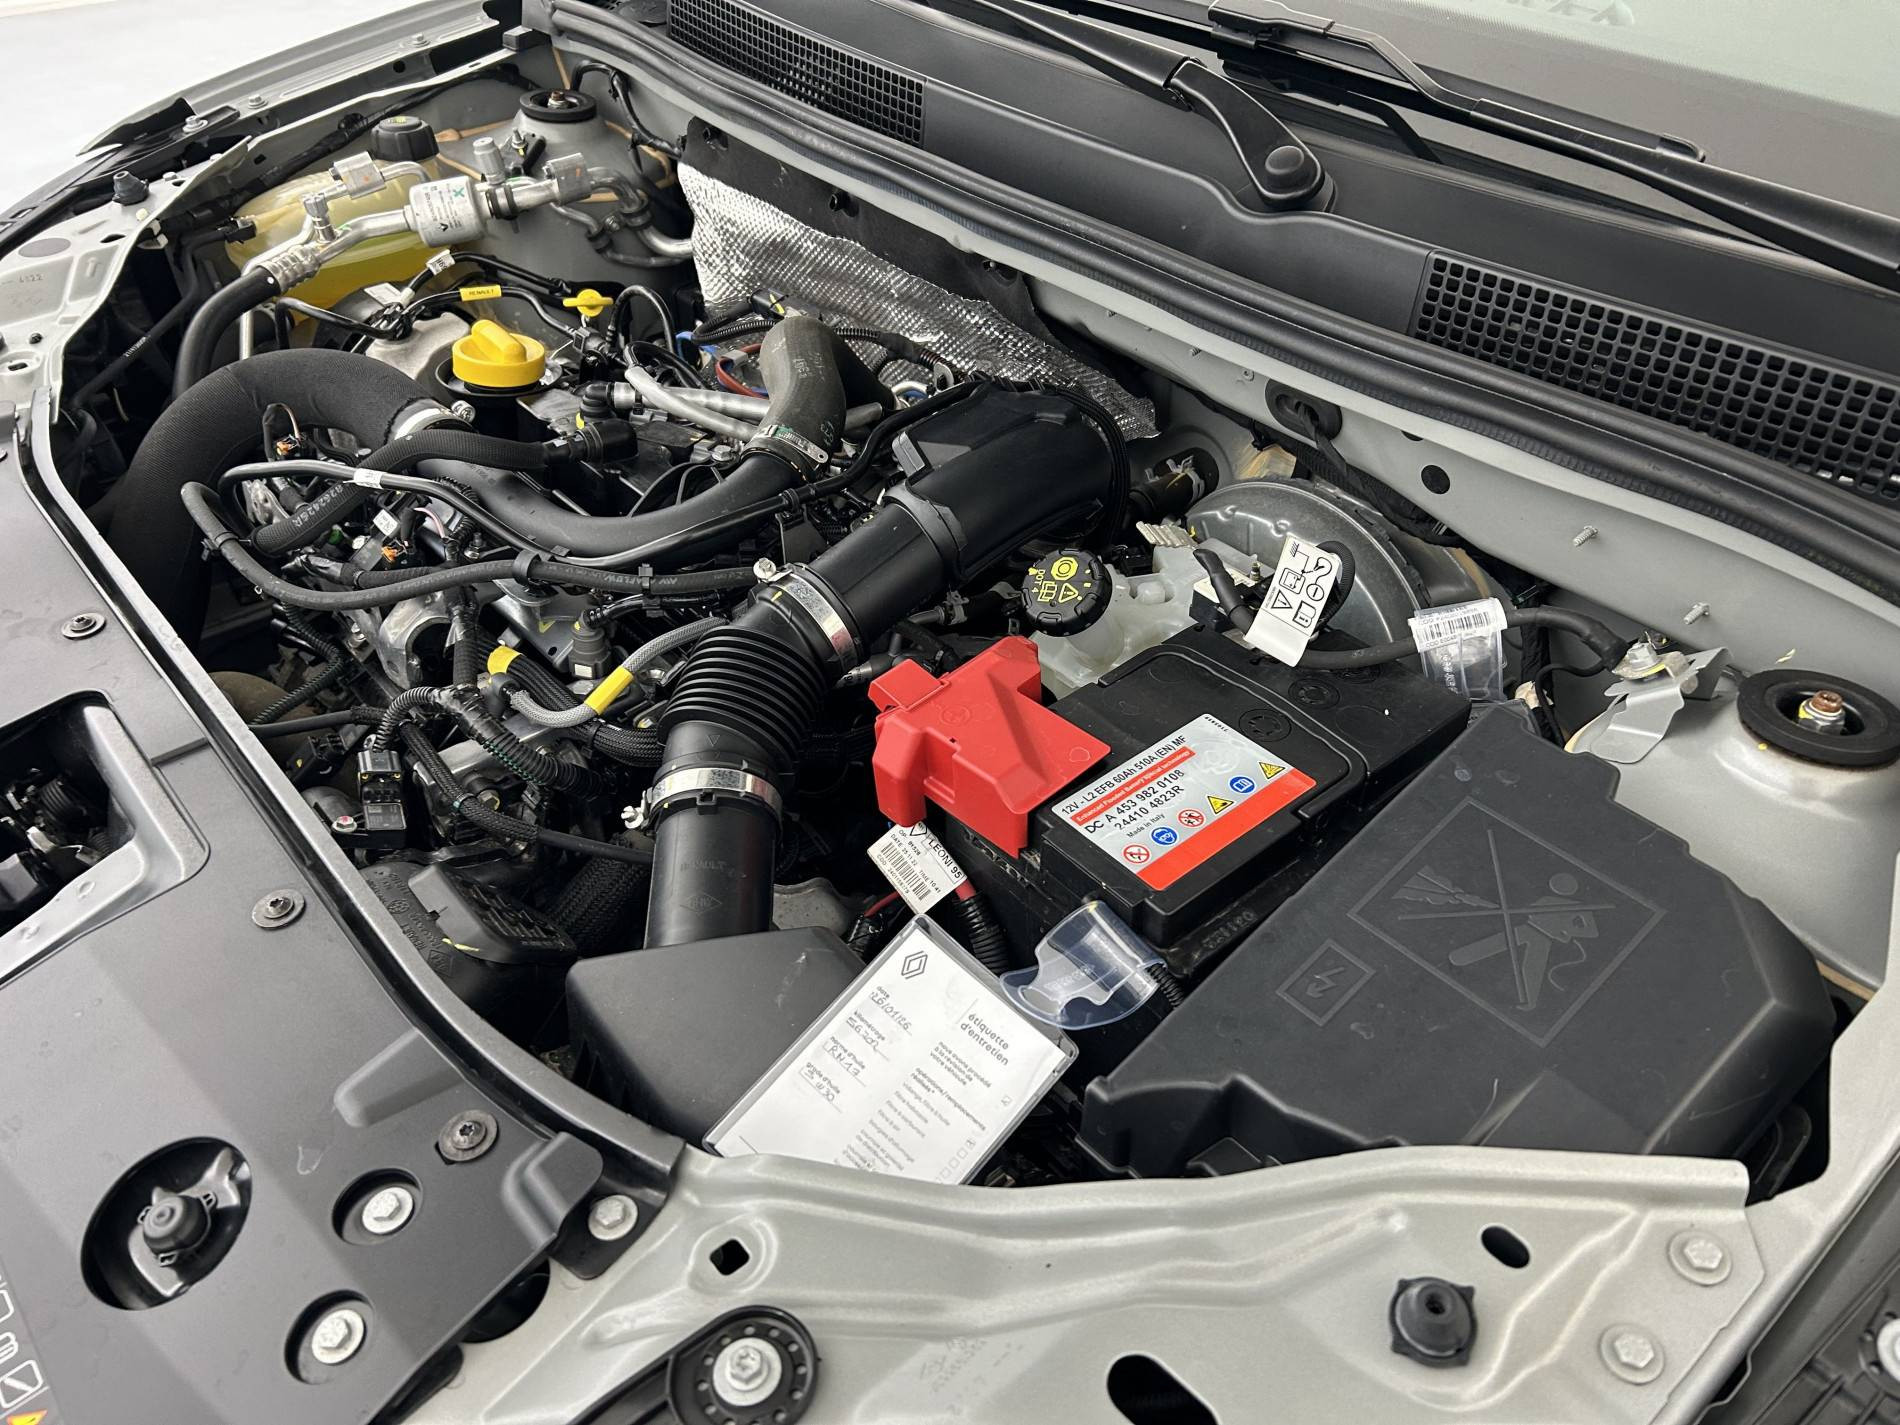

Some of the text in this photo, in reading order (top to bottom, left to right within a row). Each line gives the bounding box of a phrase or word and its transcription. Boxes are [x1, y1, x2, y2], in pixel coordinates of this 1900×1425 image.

[1034, 569, 1046, 585] DOT
[1061, 801, 1079, 814] 12V
[1081, 791, 1098, 802] L2
[1093, 780, 1115, 794] EFB
[1112, 768, 1137, 783] 60Ah
[1133, 755, 1158, 770] 510A
[1153, 743, 1176, 758] (EN)
[1170, 734, 1186, 746] MF
[1115, 799, 1137, 814] 453
[1135, 786, 1159, 801] 982
[1156, 769, 1184, 788] 0108
[1113, 785, 1184, 830] 24410 4823R
[1125, 826, 1145, 837] Made
[1149, 813, 1165, 823] Italy
[927, 838, 962, 878] LEONI 95
[960, 1022, 1008, 1065] d'entretien
[967, 1013, 1008, 1049] étiquette
